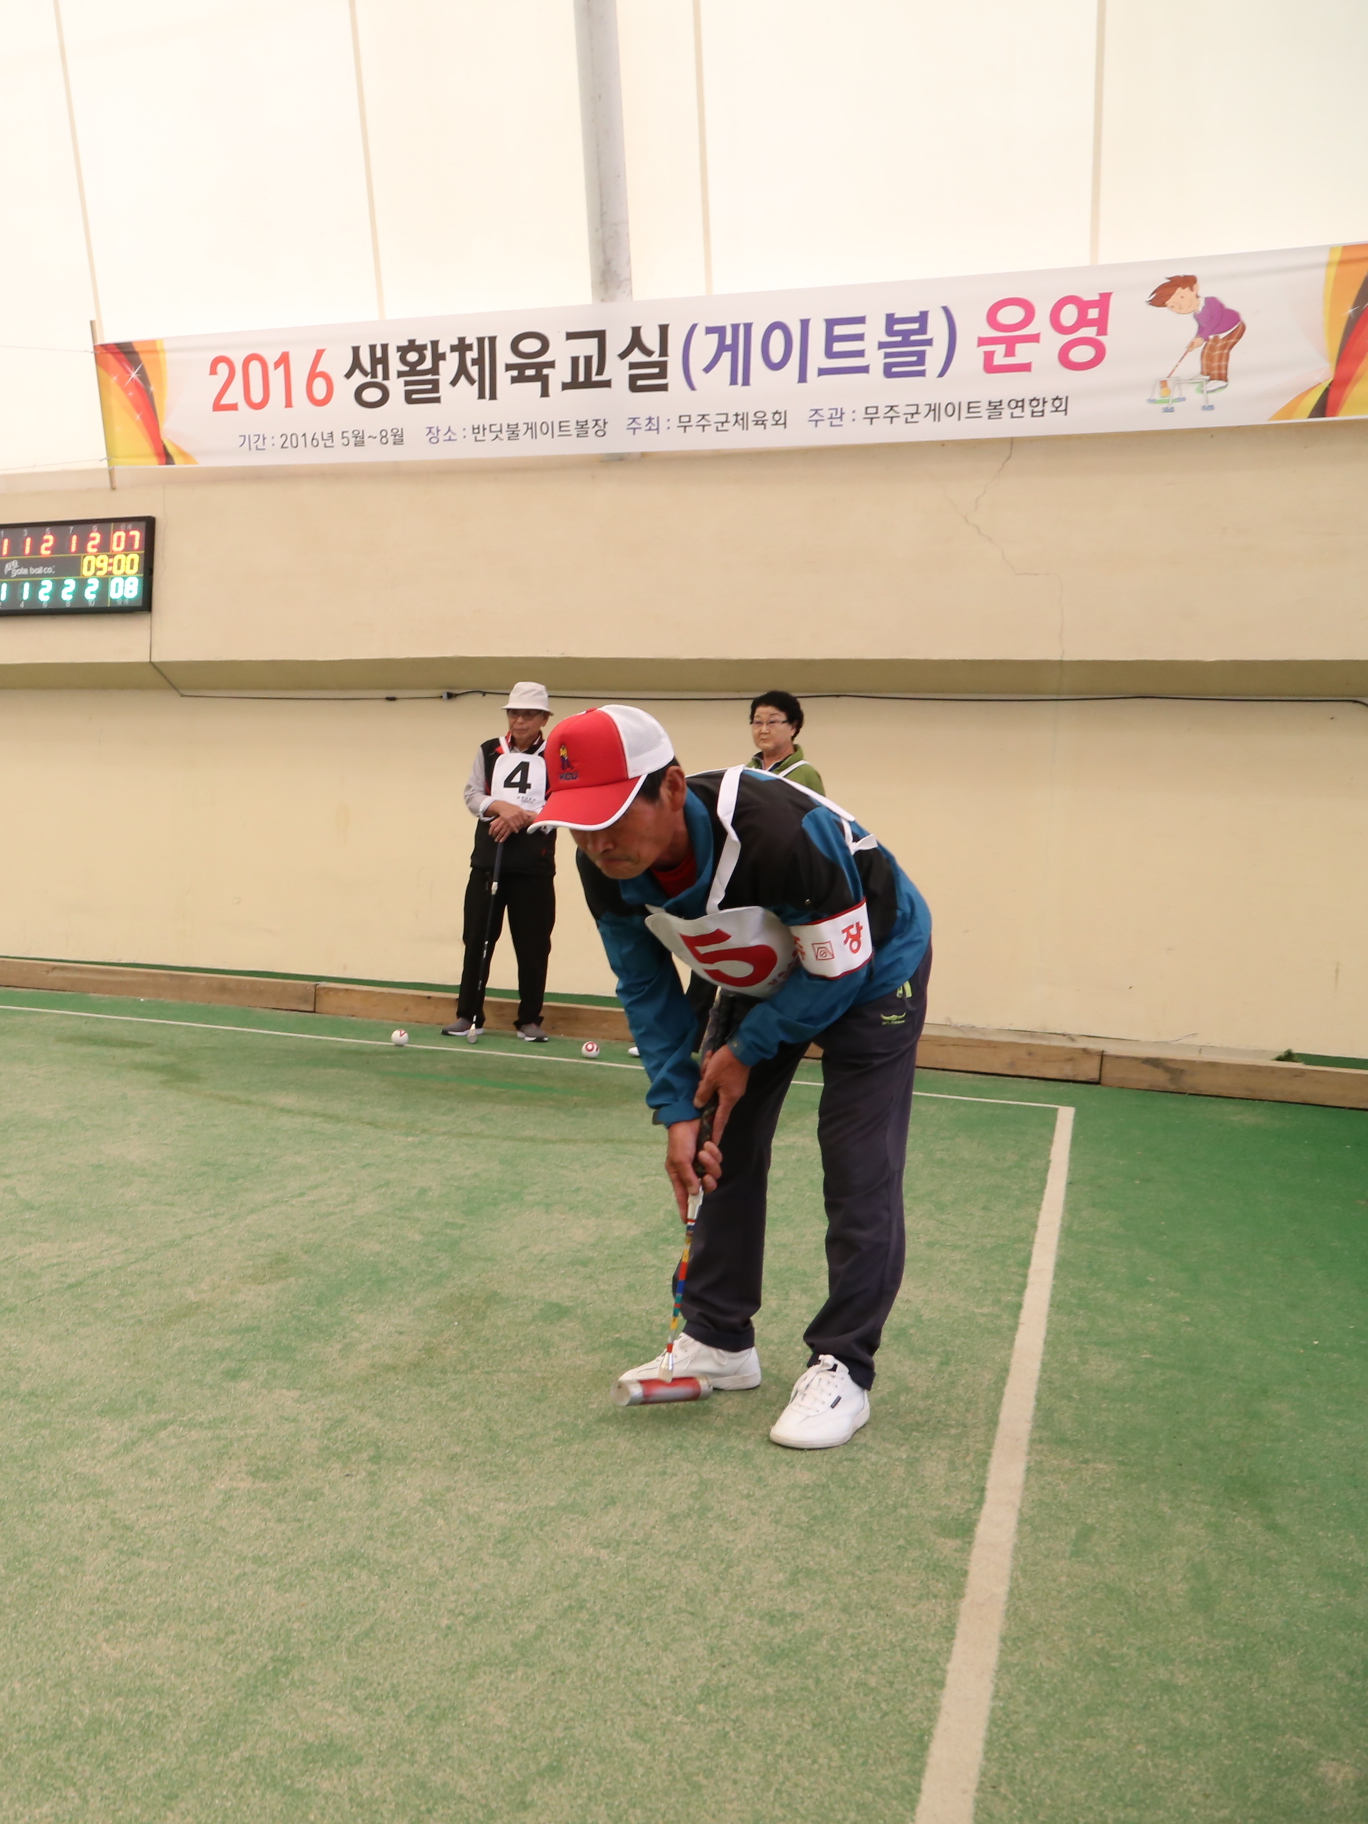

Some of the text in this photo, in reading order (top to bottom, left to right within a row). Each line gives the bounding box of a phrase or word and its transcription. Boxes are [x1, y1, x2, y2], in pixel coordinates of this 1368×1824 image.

[209, 348, 335, 413] 2016
[976, 292, 1114, 375] 운영
[279, 430, 335, 449] 2016년
[340, 427, 405, 447] 5월~8월
[471, 418, 609, 443] 반딧불게이트볼장
[676, 409, 788, 433] 무주군체육회
[862, 395, 1069, 426] 무주군게이트볼연합회
[2, 530, 140, 556] 1 1 2 1 2 07
[82, 553, 140, 577] 09:00
[0, 576, 139, 602] 1 1 2 2 2 08
[503, 760, 532, 794] 4
[841, 921, 864, 954] 장
[679, 928, 778, 988] 5
